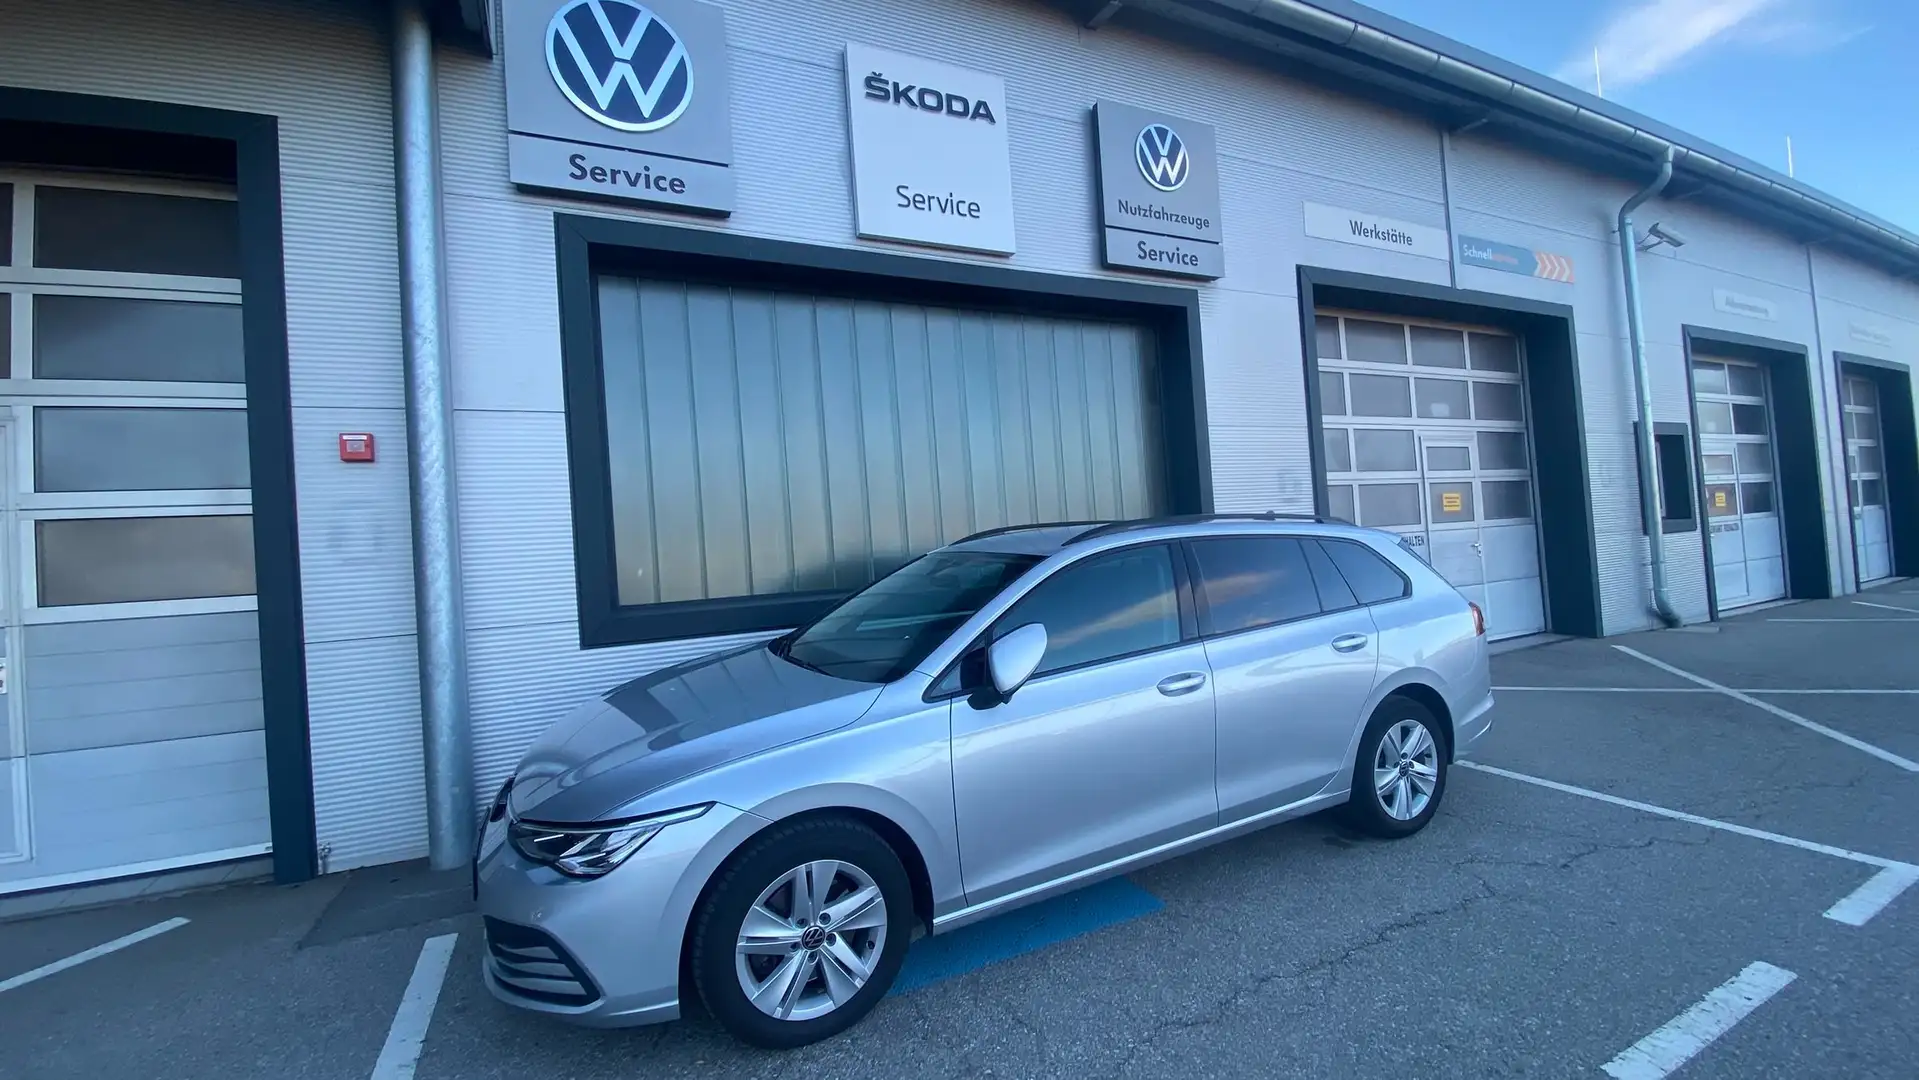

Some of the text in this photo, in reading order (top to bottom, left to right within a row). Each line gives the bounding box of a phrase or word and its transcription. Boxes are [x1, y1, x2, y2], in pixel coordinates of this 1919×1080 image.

[864, 71, 996, 124] ŠKODA
[568, 153, 686, 194] Service
[896, 184, 980, 219] Service
[1118, 199, 1210, 229] Nutzfahrzeuge
[1349, 219, 1413, 246] Werkstätte
[1137, 240, 1199, 266] Service
